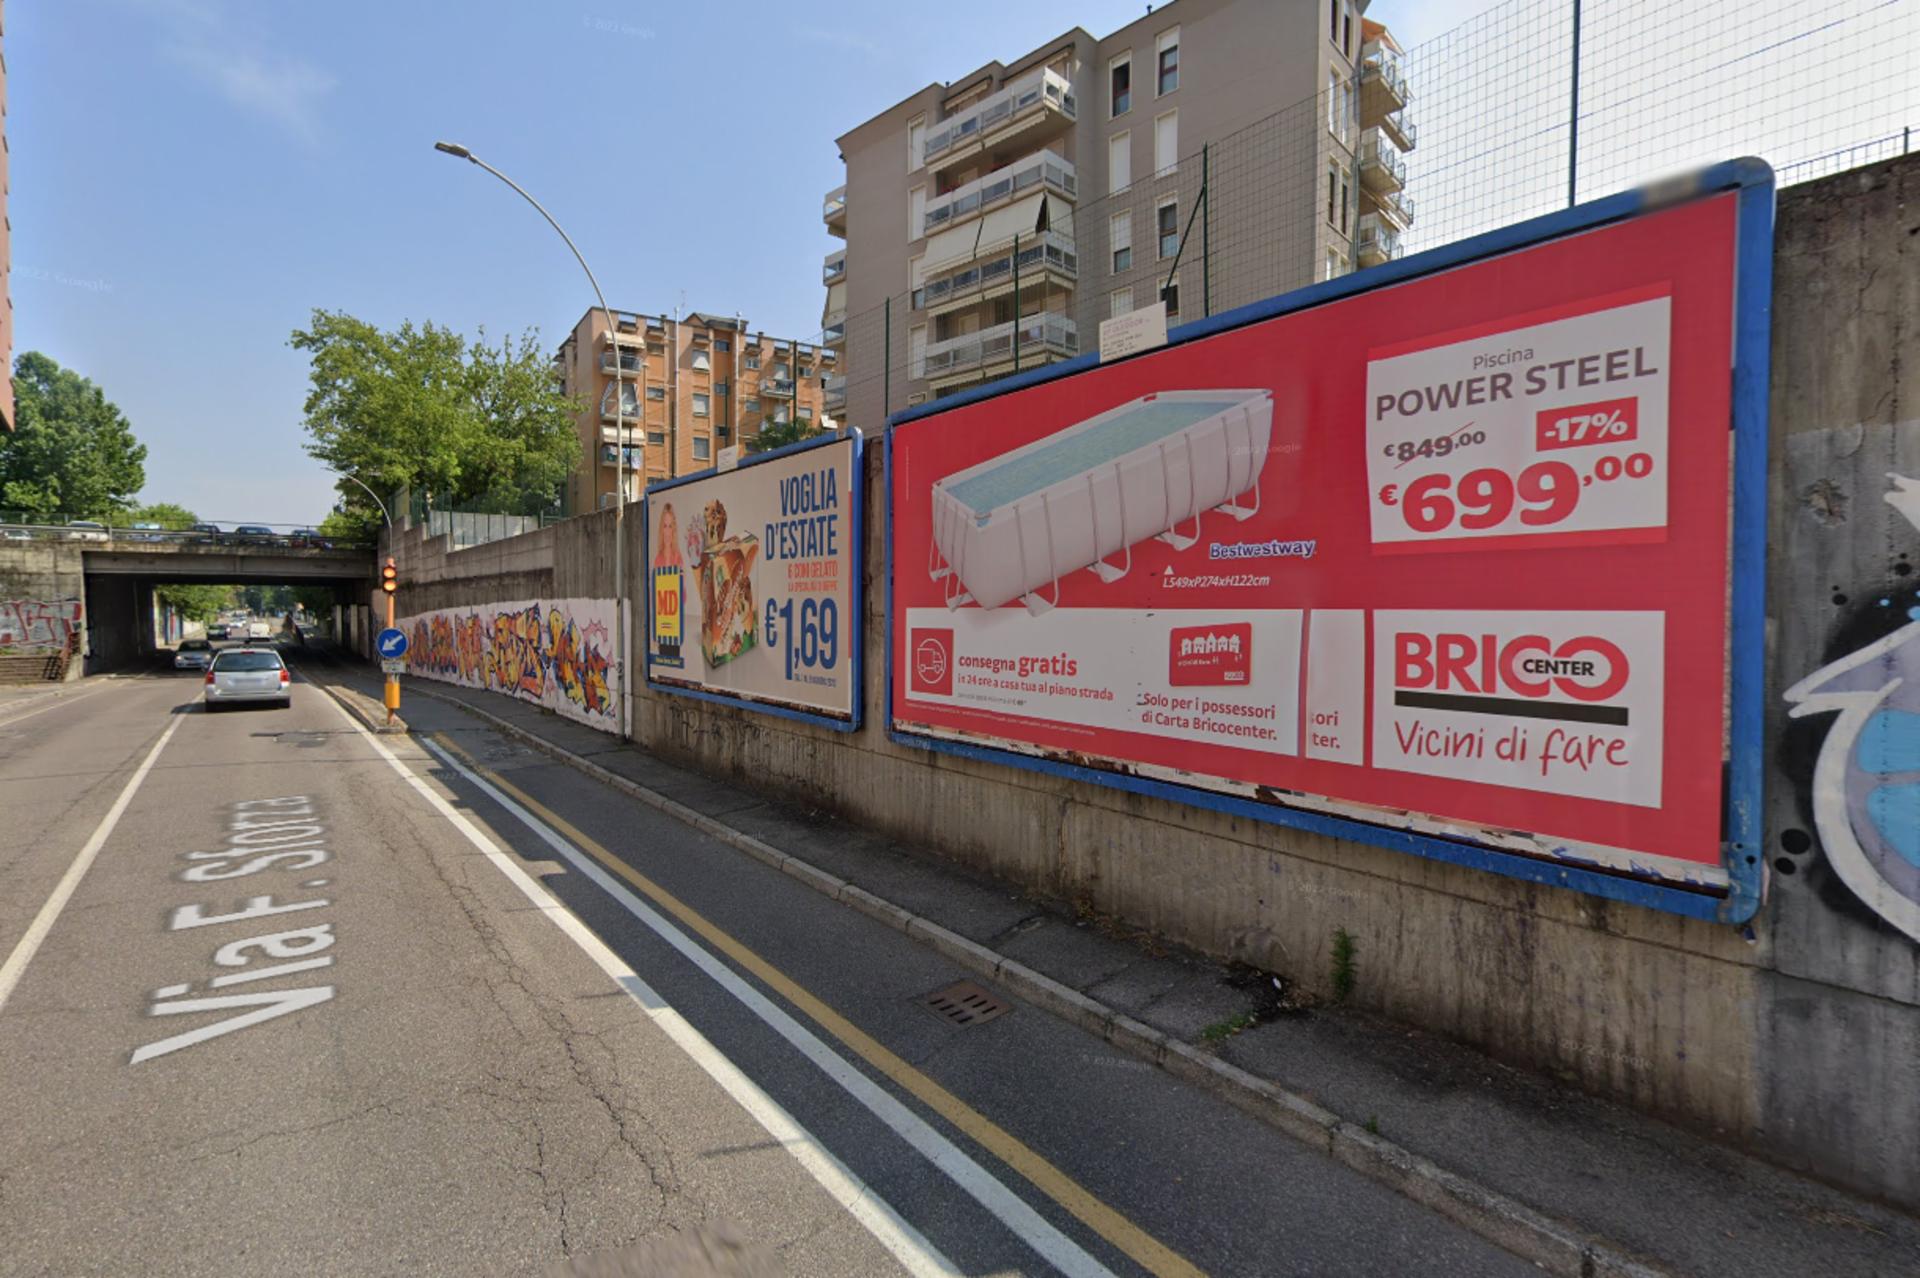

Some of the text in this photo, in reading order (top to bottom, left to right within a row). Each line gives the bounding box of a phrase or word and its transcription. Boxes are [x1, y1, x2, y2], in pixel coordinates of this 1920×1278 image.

[1473, 348, 1534, 370] Piscina
[1376, 346, 1658, 421] POWER STEEL
[1544, 409, 1628, 442] -17%
[780, 467, 837, 517] VOGLIA
[765, 514, 838, 561] D'ESTATE
[657, 589, 679, 616] MD
[959, 652, 1078, 678] consegna gratis
[1394, 632, 1630, 702] BRICO
[1522, 657, 1596, 678] CENTER
[967, 675, 977, 685] 24
[993, 679, 999, 688] a
[1038, 681, 1048, 693] al
[1049, 682, 1077, 697] piano
[1078, 687, 1114, 702] strada
[1143, 692, 1276, 720] Solo per i possessori
[1141, 710, 1278, 741] di Carta Bricocenter.
[1394, 719, 1630, 777] Vicini di fare
